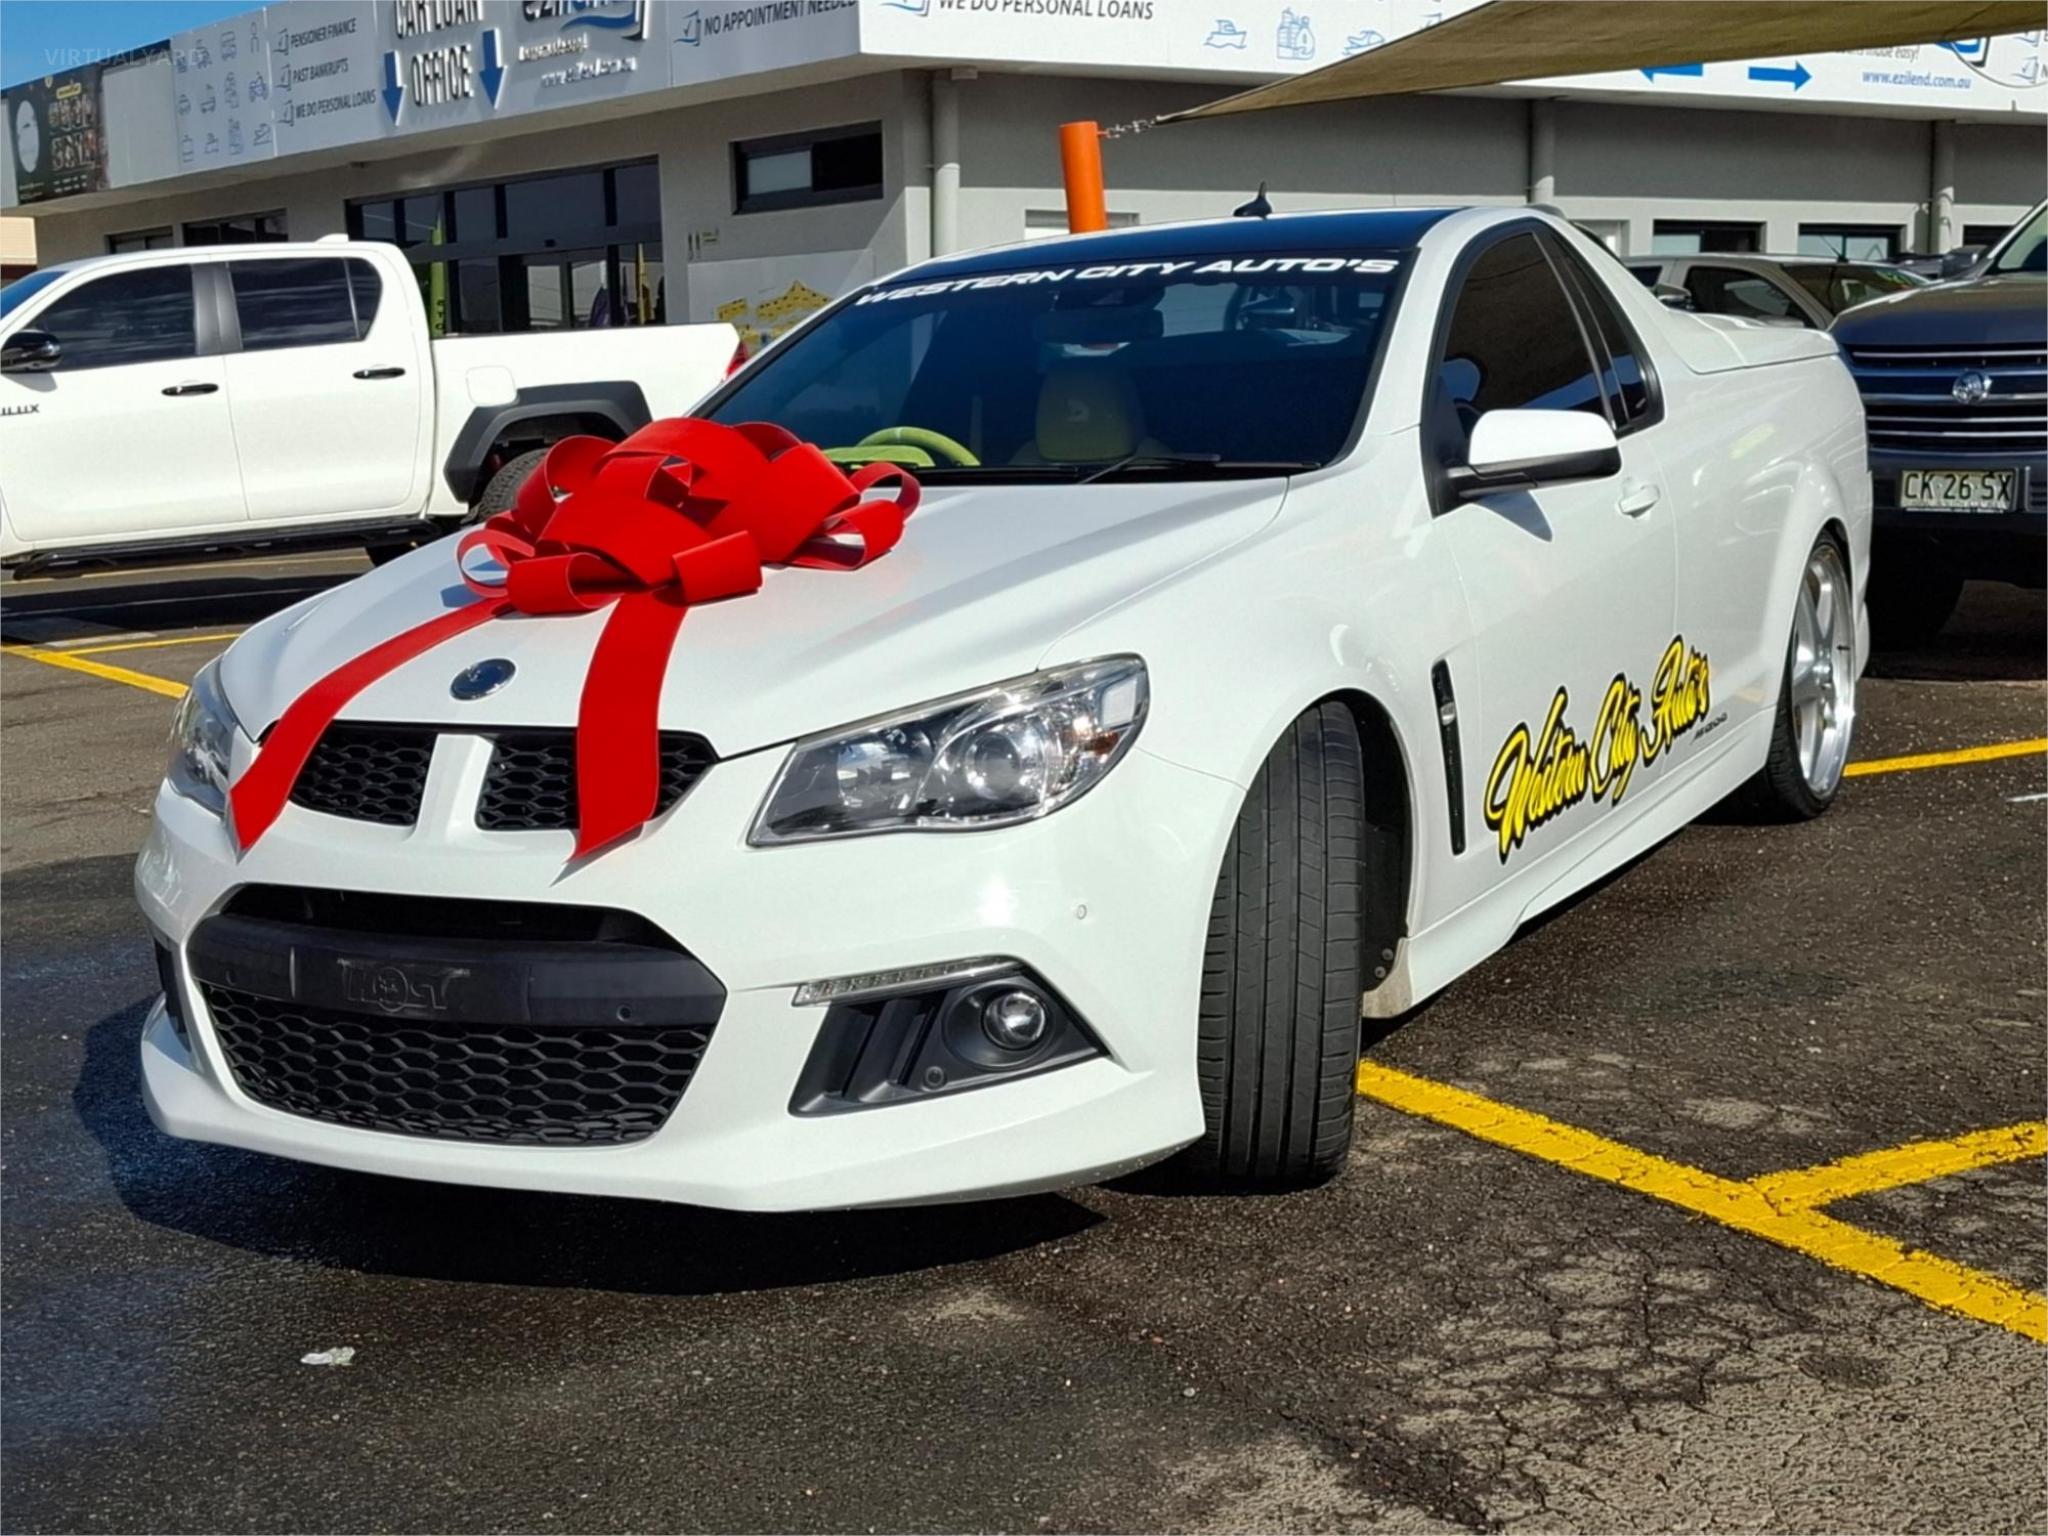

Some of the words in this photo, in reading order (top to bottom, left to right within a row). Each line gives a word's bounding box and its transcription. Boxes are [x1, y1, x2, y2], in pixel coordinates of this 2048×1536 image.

[703, 15, 722, 36] NO
[722, 0, 805, 32] APPOINTMENT
[970, 0, 998, 11] DO
[1002, 0, 1094, 17] PERSONAL
[1096, 0, 1154, 20] LOANS
[327, 17, 357, 37] FINANCE
[292, 67, 309, 84] PAST
[309, 57, 349, 80] BANKRUPTS
[411, 44, 475, 107] OFFICE
[1862, 70, 1972, 89] www.ezilend.com.au
[318, 94, 352, 114] PERSONAL
[352, 88, 377, 108] LOANS
[855, 268, 1075, 305] WESTERN
[1074, 261, 1197, 280] CITY
[1192, 257, 1400, 274] AUTO'S
[0, 403, 40, 417] ILUX
[1904, 471, 1935, 500] CK
[1943, 473, 1972, 501] 26
[1980, 471, 2012, 502] SX
[1588, 672, 1642, 807] City
